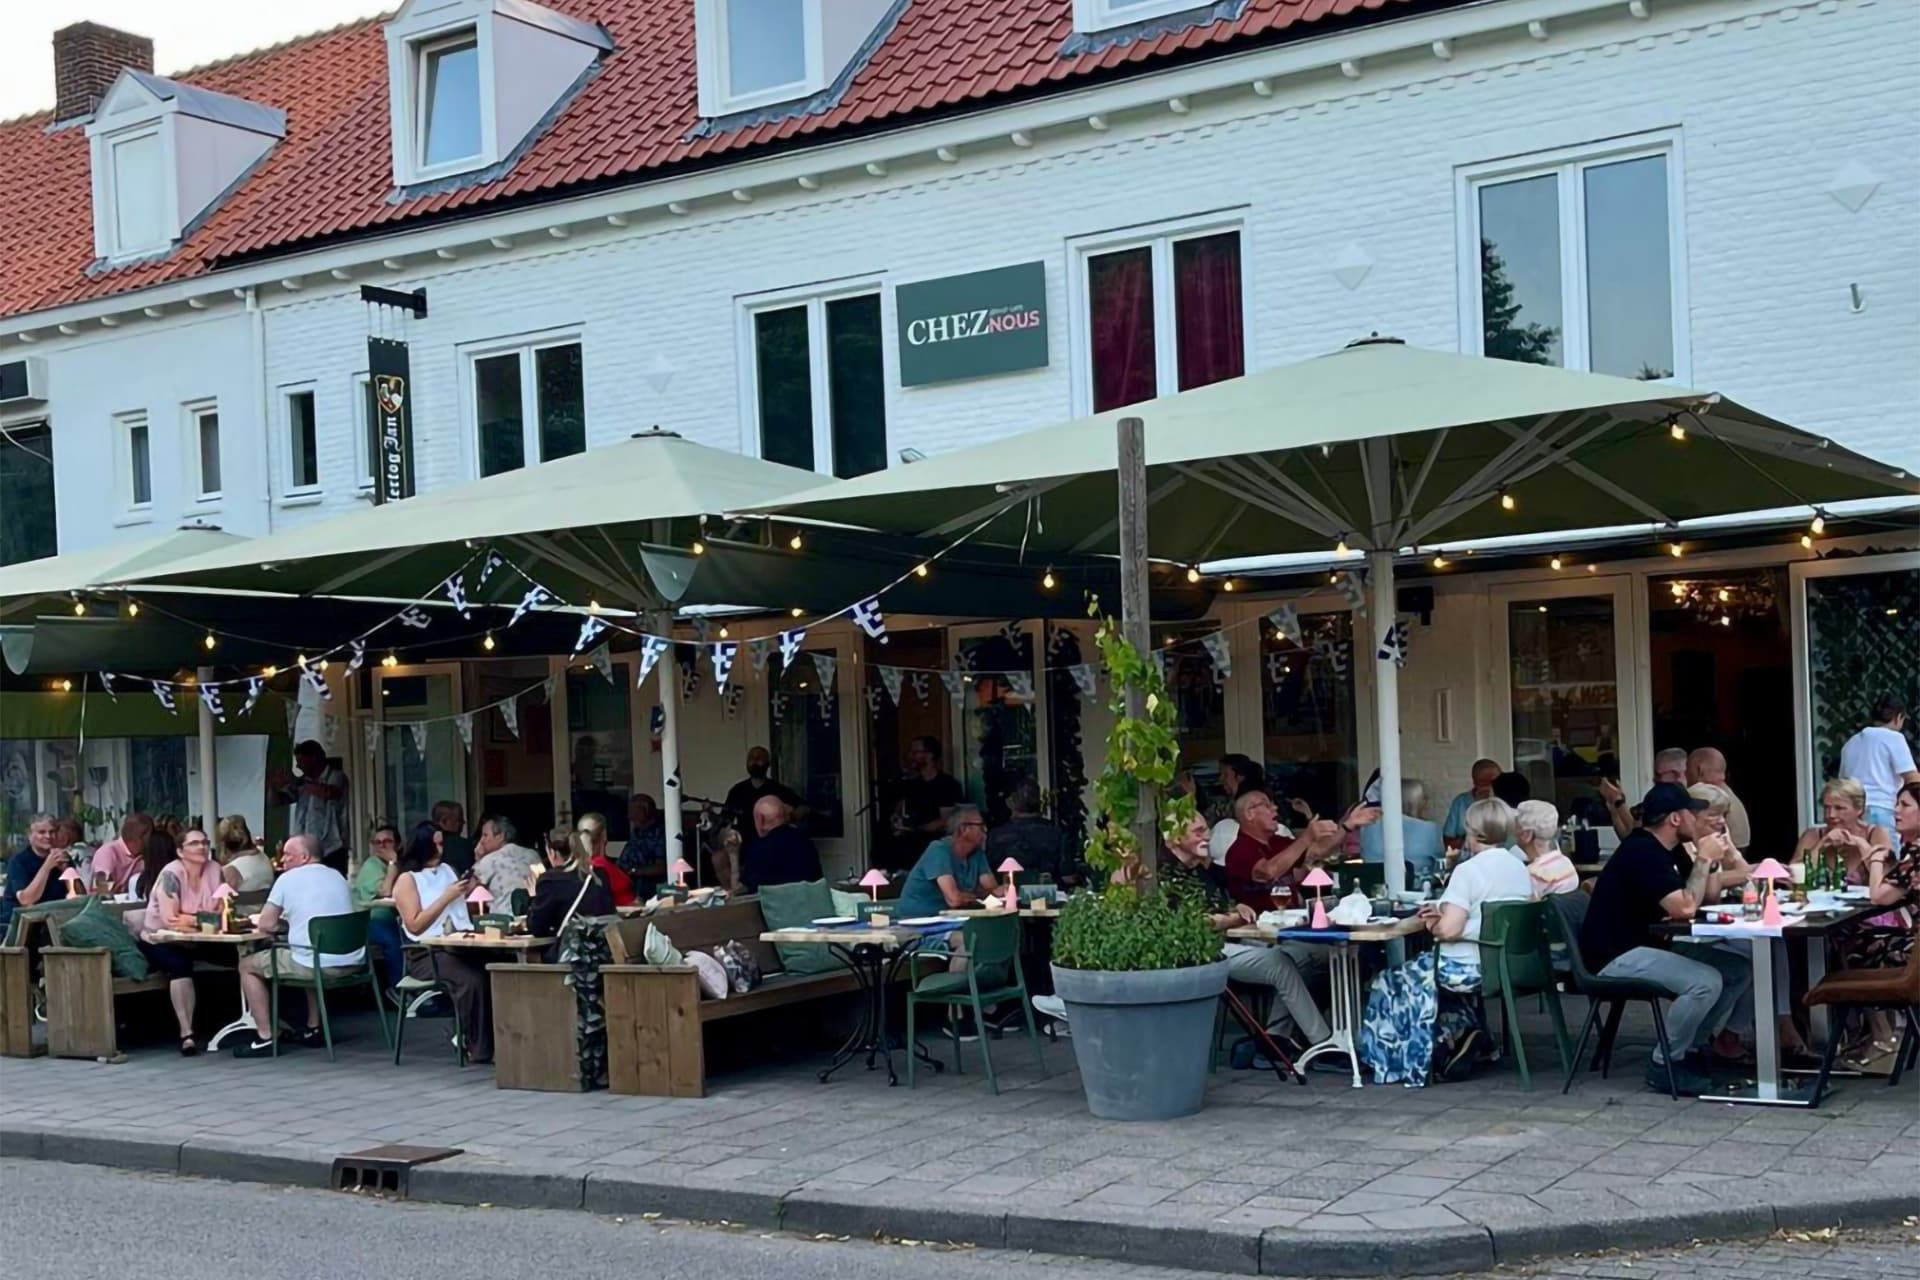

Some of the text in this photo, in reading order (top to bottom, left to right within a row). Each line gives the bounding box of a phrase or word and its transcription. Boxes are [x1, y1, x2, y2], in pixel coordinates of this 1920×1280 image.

[907, 309, 989, 345] CHEZ
[988, 310, 1040, 333] NOUS
[384, 416, 402, 452] Jan
